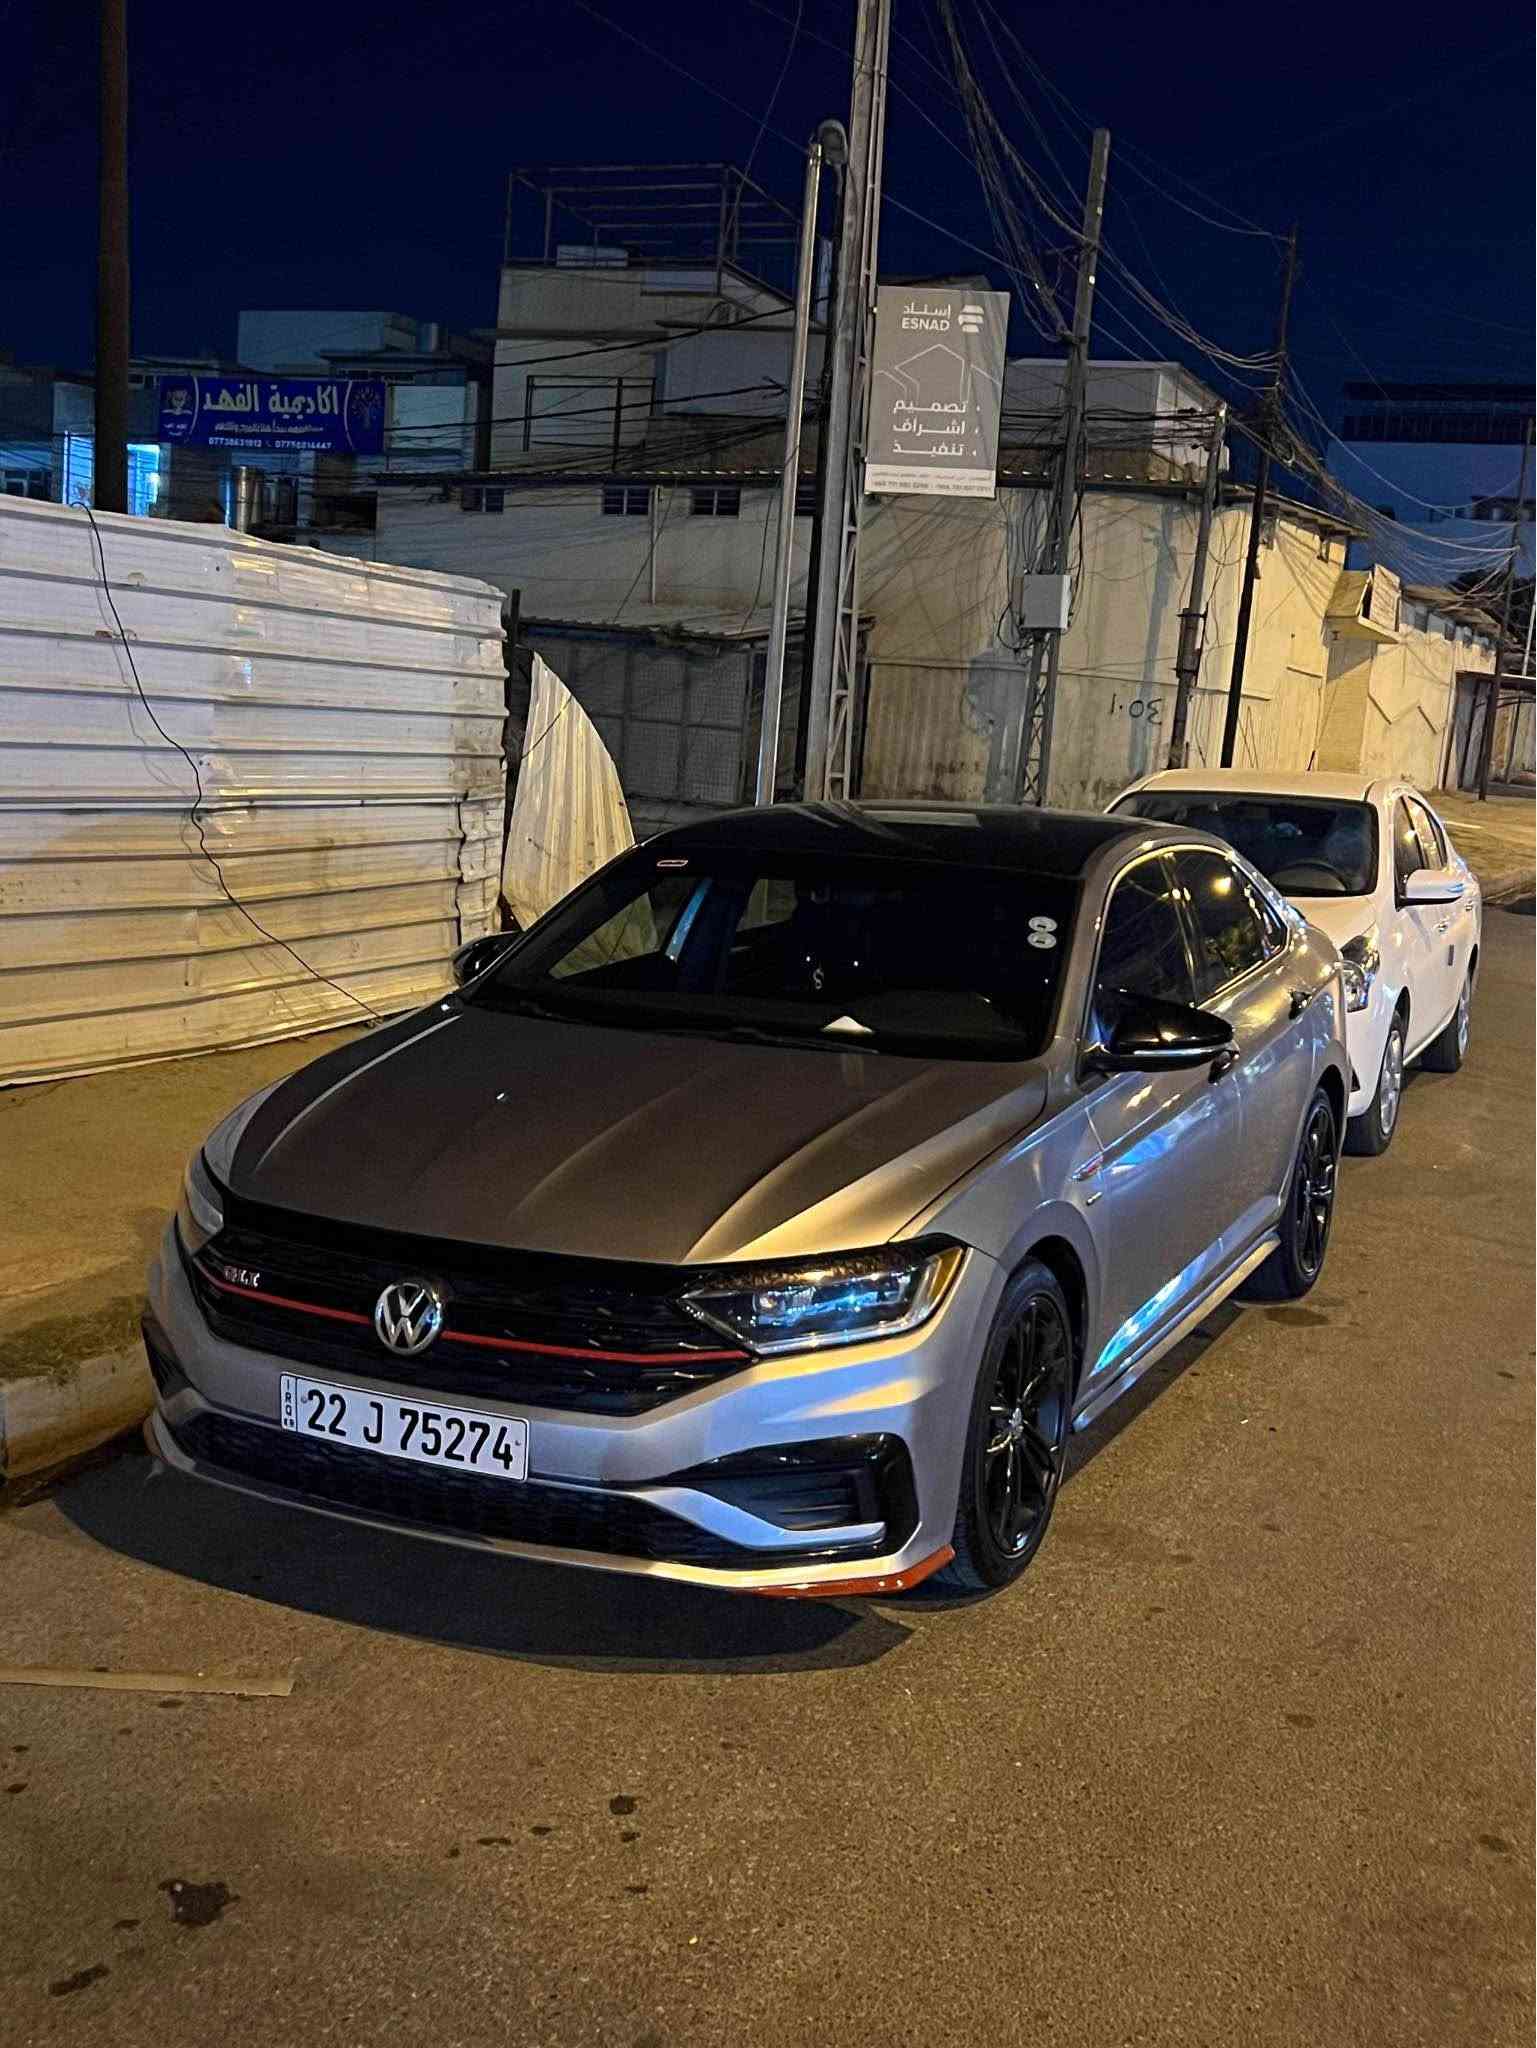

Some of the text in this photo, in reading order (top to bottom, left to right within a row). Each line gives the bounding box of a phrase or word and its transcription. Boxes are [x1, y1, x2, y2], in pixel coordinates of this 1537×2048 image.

[901, 317, 950, 331] ESNAD
[203, 383, 260, 413] الفهد
[893, 399, 969, 414] تصميم
[892, 417, 966, 436] اشراف
[892, 439, 965, 457] تنفيذ
[307, 1389, 513, 1470] 22 J 75274
